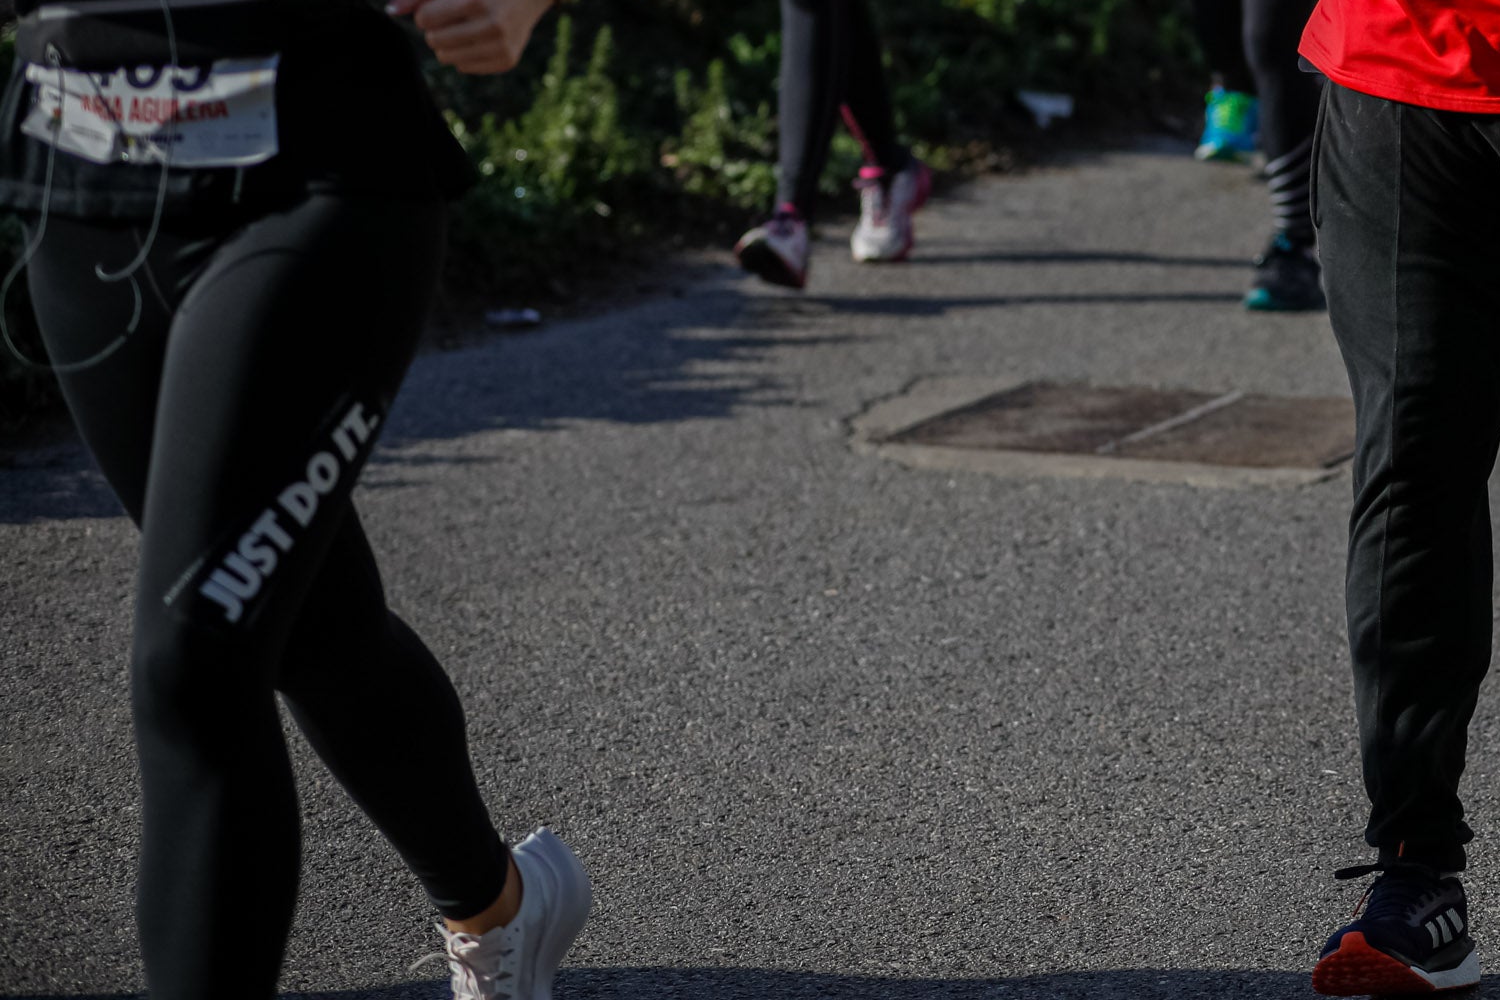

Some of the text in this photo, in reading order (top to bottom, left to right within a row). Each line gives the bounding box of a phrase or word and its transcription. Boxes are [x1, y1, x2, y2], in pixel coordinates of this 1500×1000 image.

[200, 402, 379, 624] JUST DO IT.
